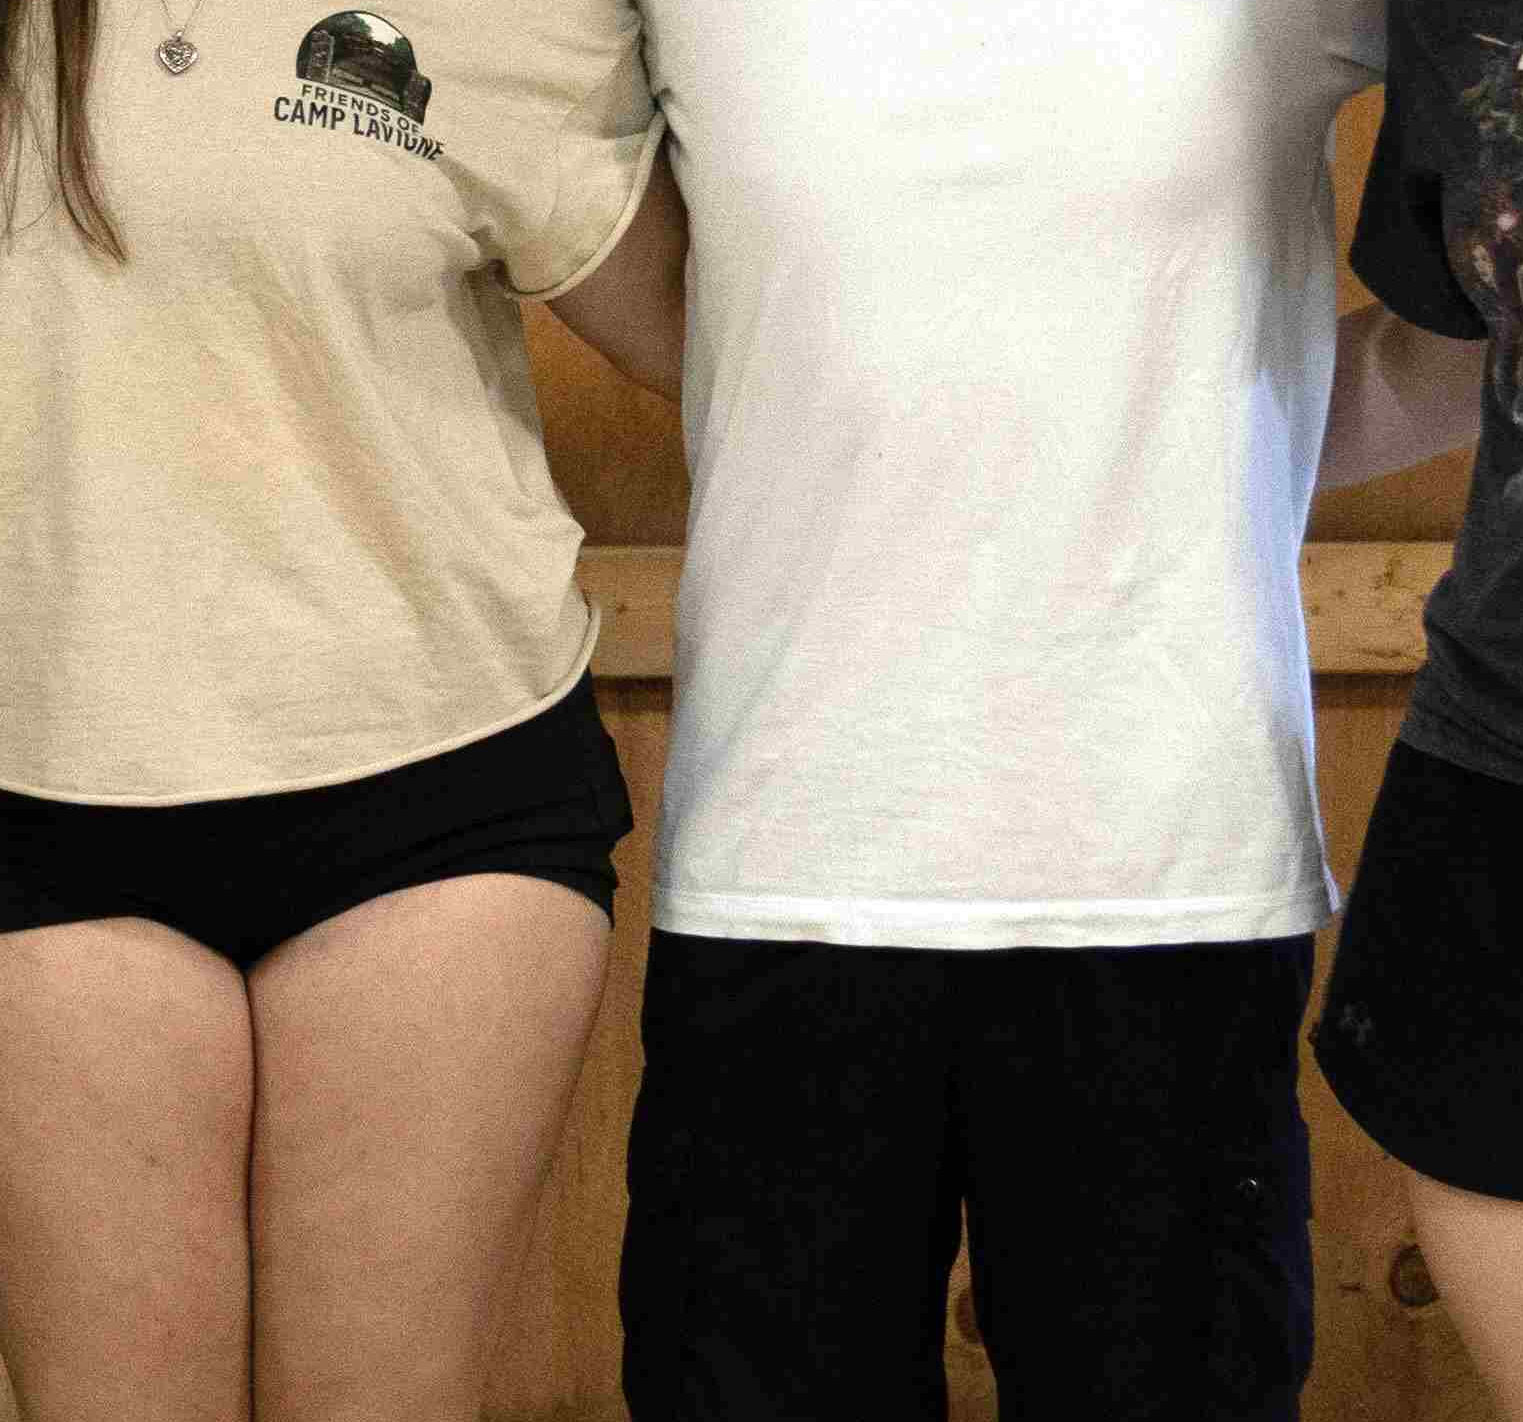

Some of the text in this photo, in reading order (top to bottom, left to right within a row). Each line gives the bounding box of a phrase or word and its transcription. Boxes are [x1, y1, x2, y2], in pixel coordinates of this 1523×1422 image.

[274, 96, 444, 161] CAMP LAVIGNE
[302, 84, 392, 123] FRIENDS
